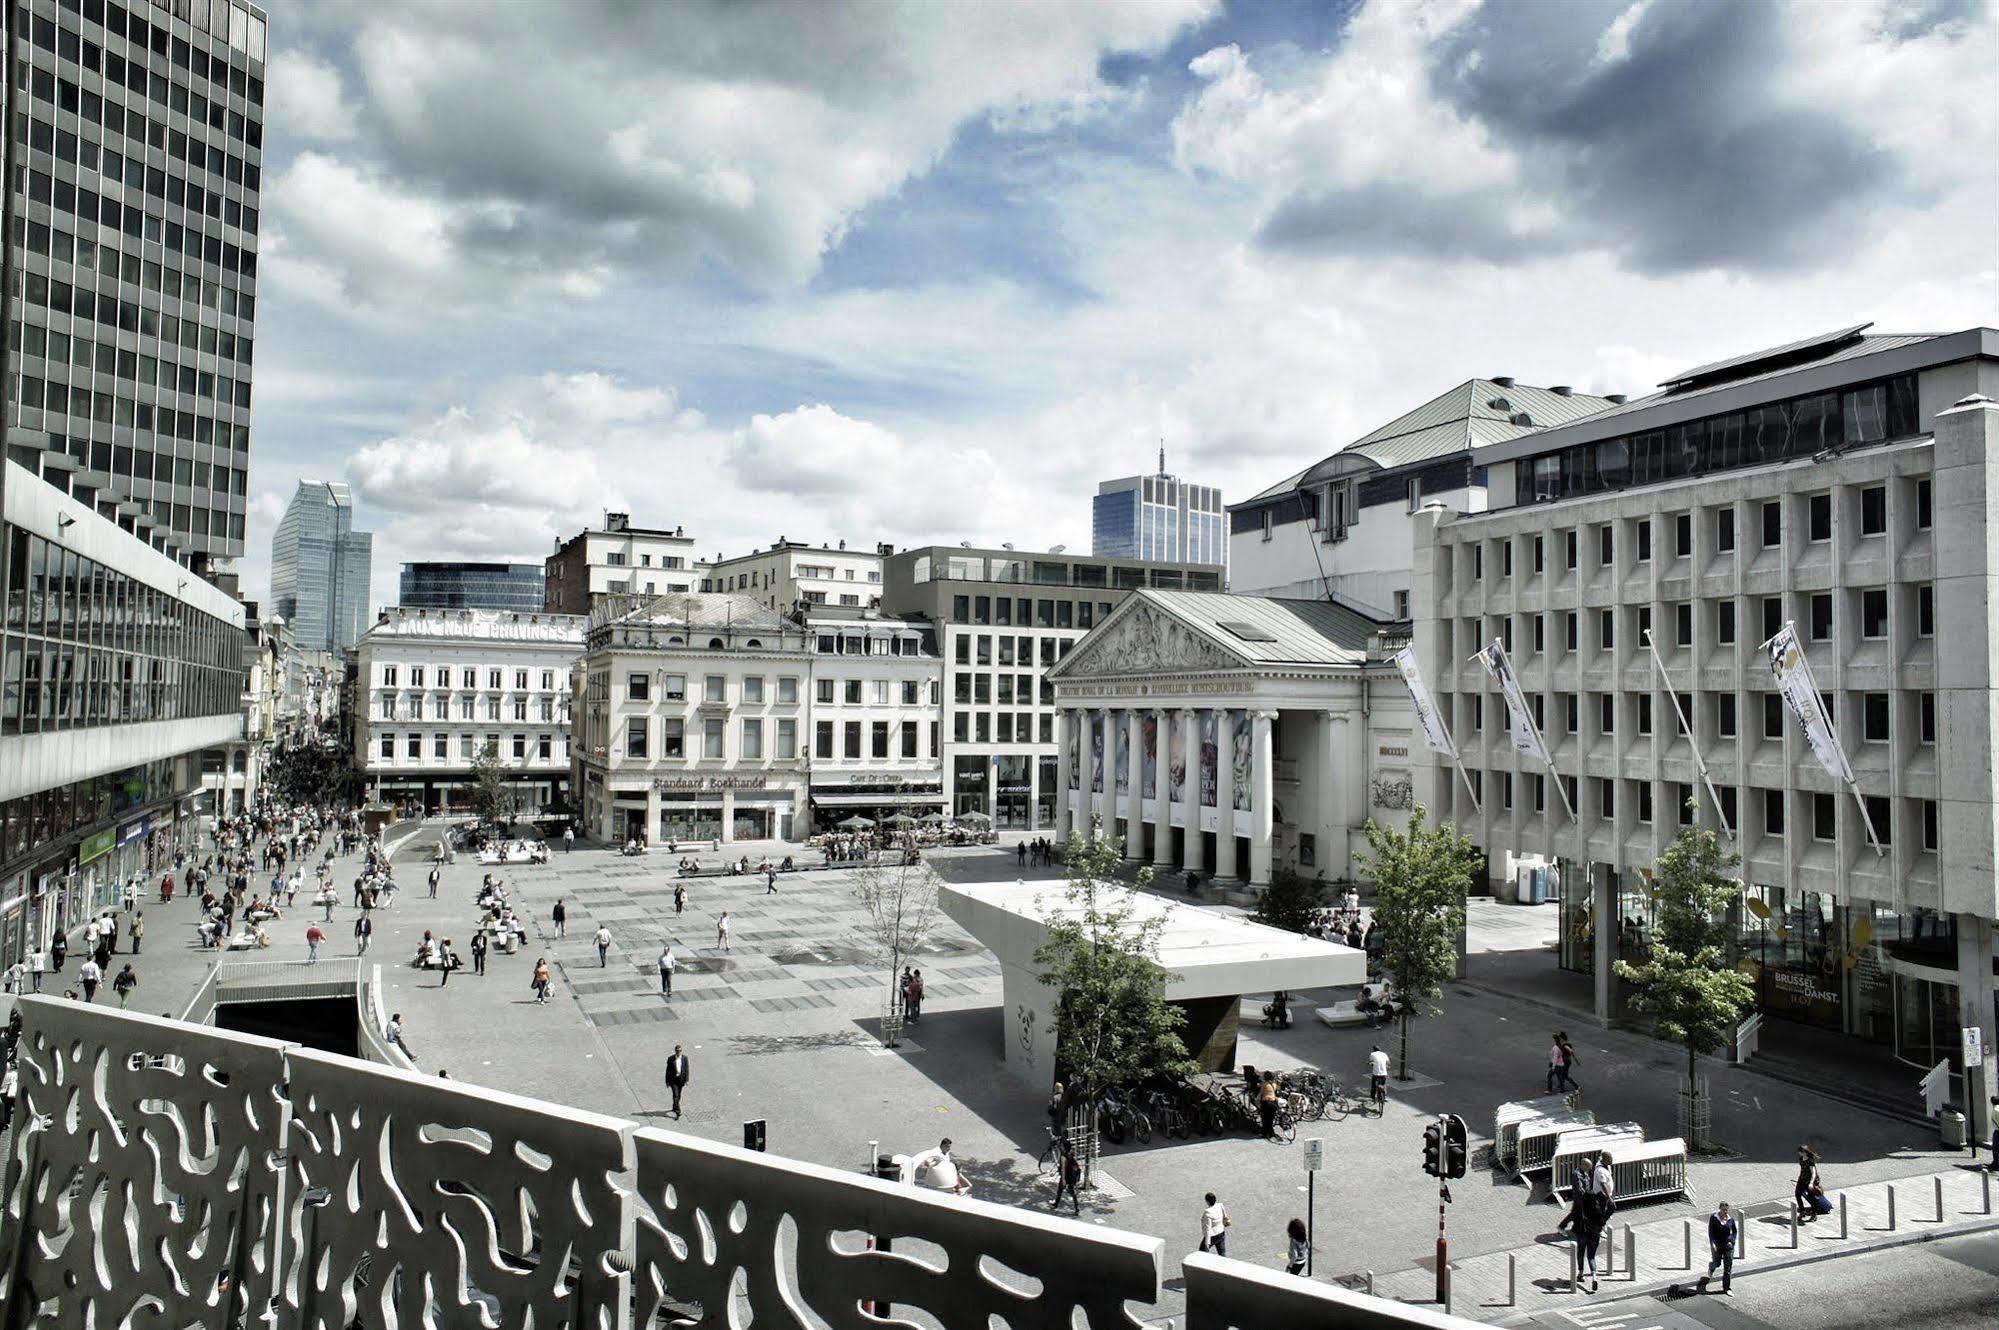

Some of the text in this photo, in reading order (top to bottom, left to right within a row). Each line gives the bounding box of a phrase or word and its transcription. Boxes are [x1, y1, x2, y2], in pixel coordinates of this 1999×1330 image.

[653, 778, 767, 789] Standaard Boekhandel
[1775, 972, 1815, 989] BRUSSEL
